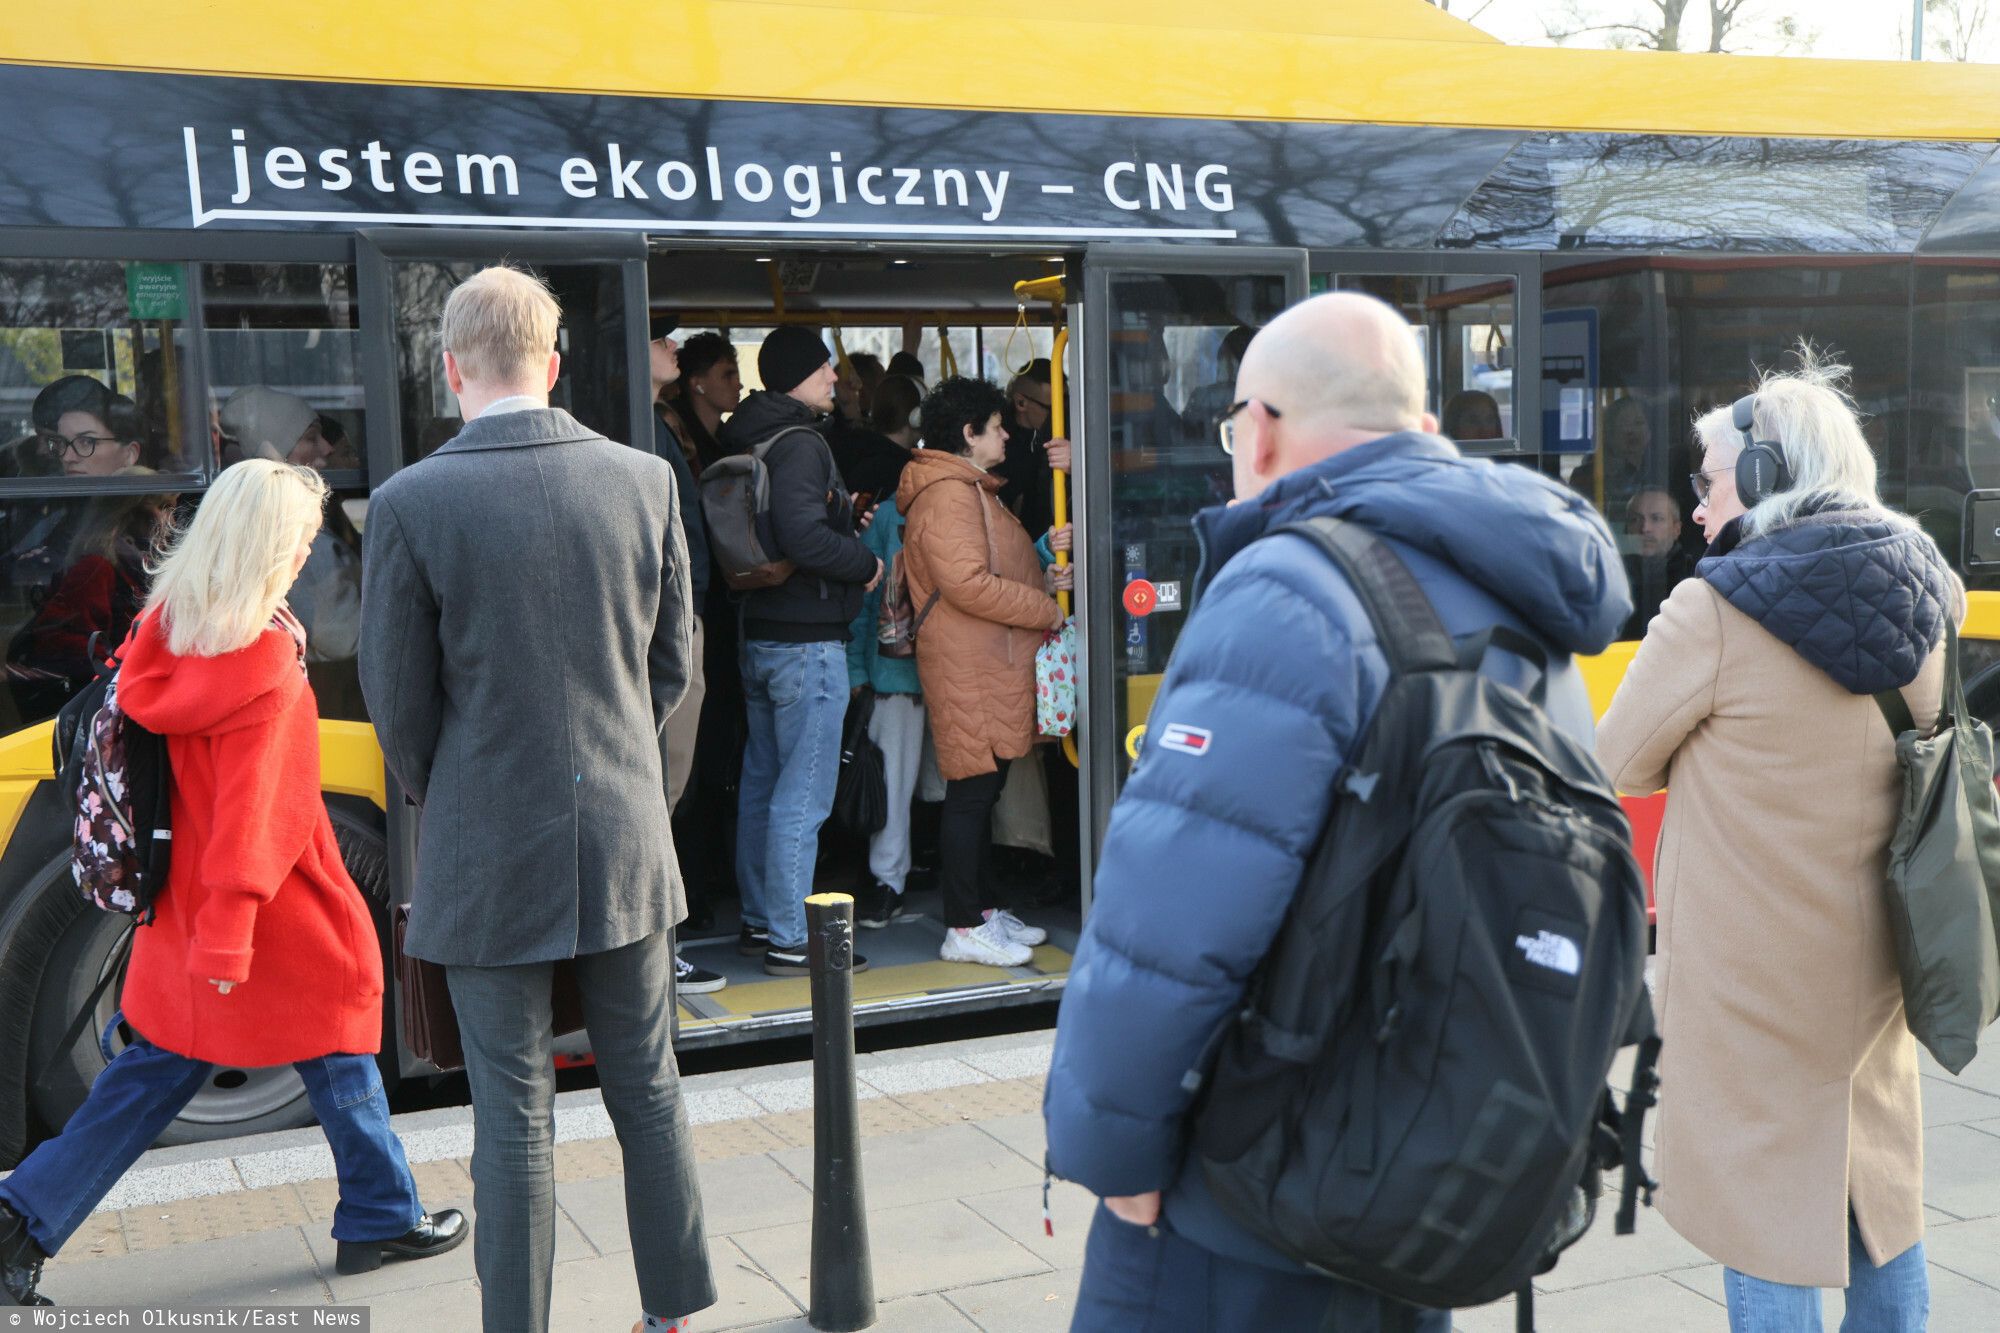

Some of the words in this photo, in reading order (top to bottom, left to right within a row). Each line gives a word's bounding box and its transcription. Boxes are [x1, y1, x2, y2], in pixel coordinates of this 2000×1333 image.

[231, 128, 520, 204] jestem
[560, 143, 1010, 222] ekologiczny
[1103, 161, 1235, 212] CNG
